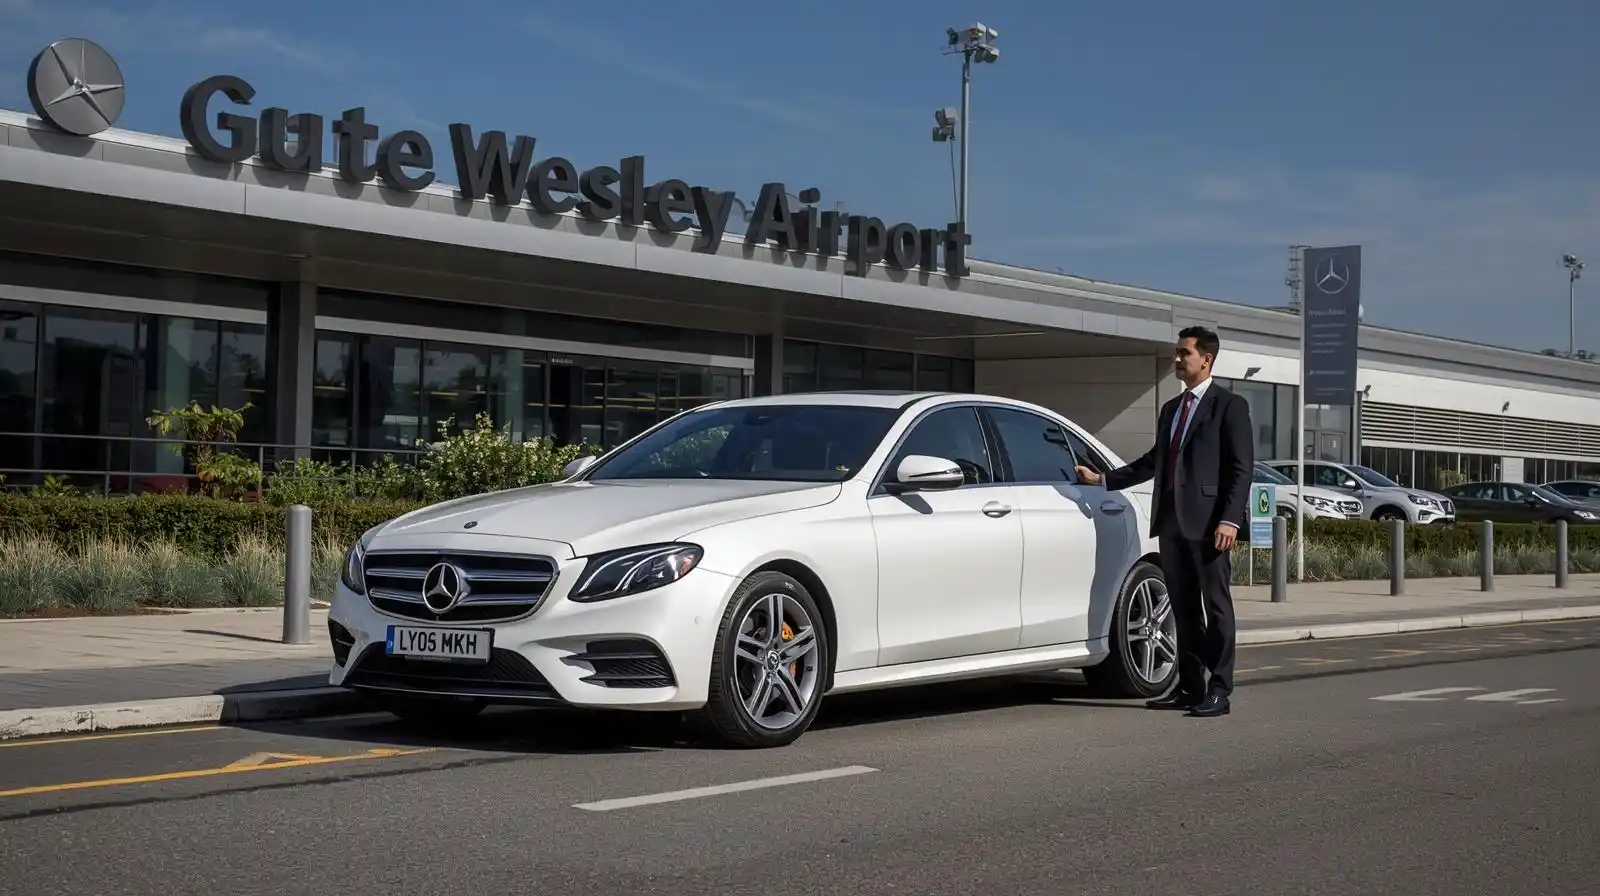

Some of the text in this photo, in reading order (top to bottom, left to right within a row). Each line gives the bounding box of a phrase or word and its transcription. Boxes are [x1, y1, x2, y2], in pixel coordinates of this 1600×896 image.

[180, 75, 972, 278] Gute Wesley Airport
[441, 633, 477, 655] MKH
